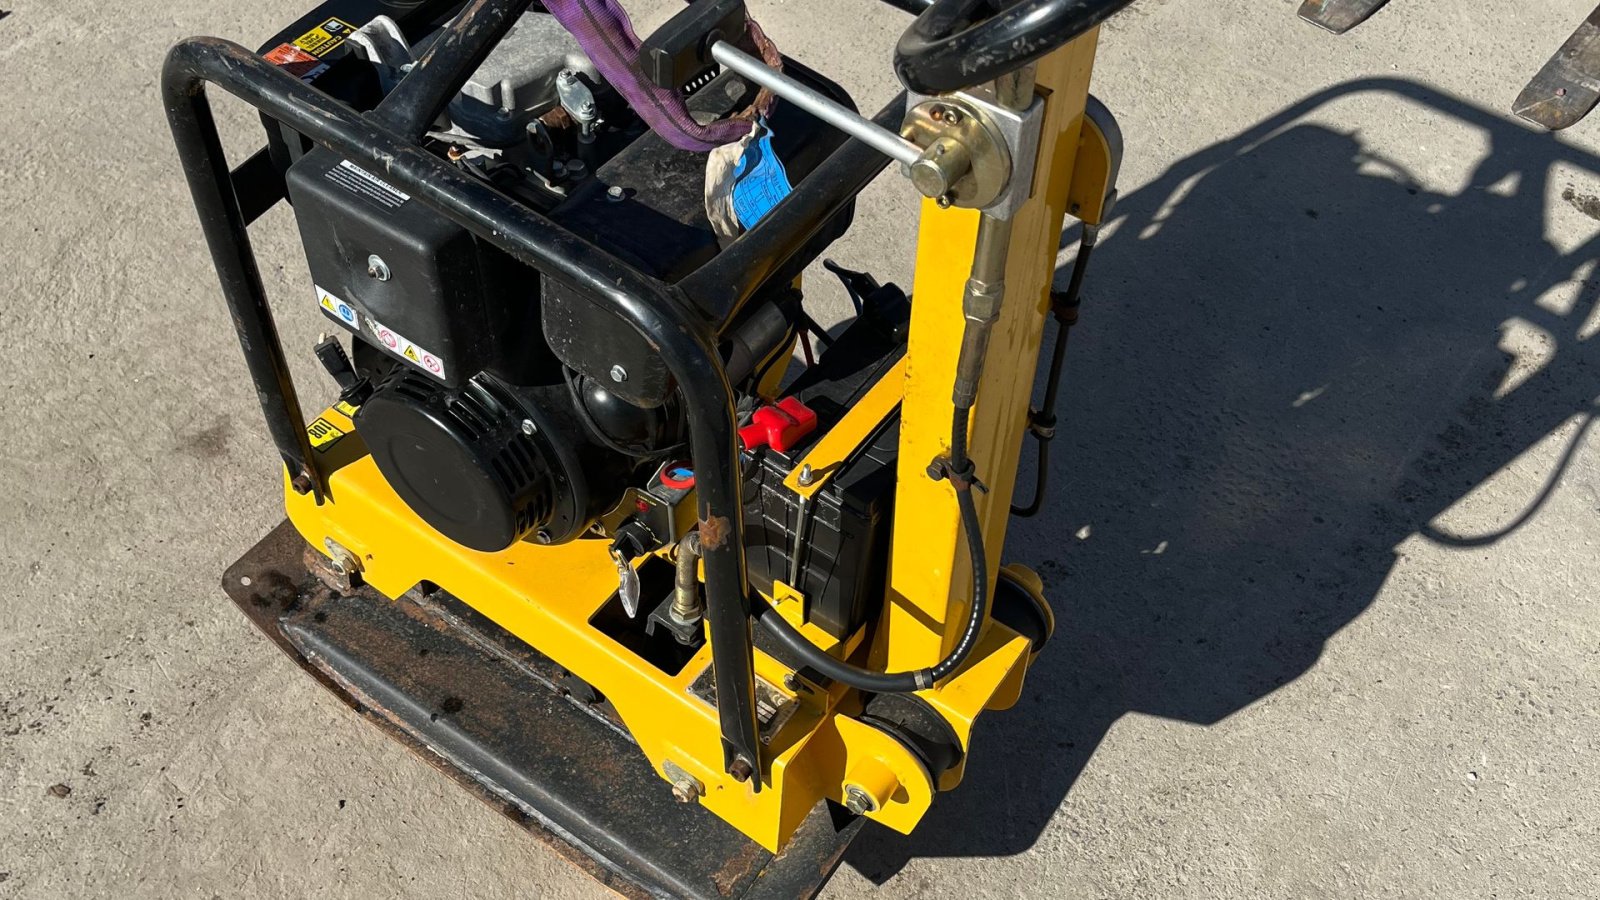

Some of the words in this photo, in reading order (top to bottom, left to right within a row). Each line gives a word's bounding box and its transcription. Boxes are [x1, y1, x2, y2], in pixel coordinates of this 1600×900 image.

[311, 35, 342, 56] CAUTION
[308, 421, 332, 439] 108
[771, 693, 786, 706] CE
